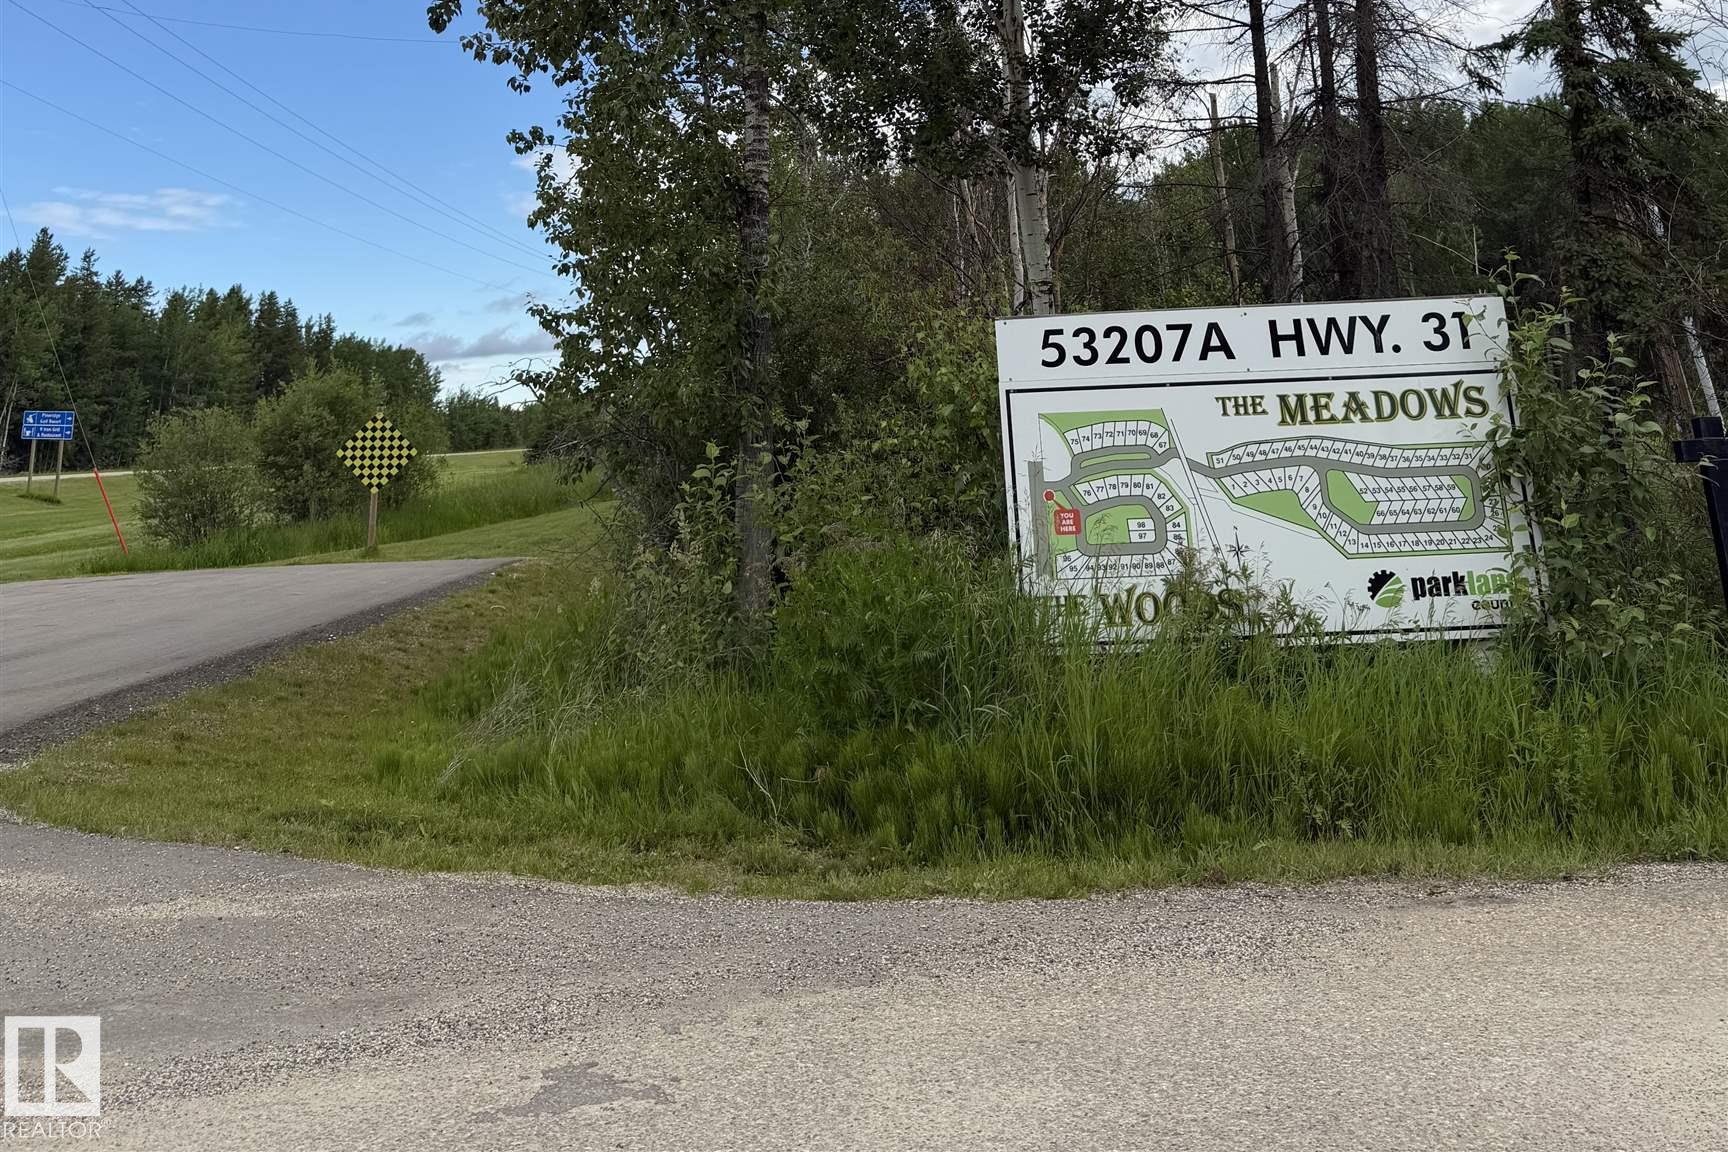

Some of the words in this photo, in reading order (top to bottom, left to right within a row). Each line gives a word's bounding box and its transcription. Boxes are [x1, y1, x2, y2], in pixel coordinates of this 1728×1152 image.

[1041, 321, 1237, 368] 53207A
[1268, 314, 1402, 358] HWY.
[1421, 311, 1472, 351] 31
[1214, 394, 1269, 417] THE
[1276, 378, 1490, 426] MEADOWS
[1121, 562, 1128, 570] 91
